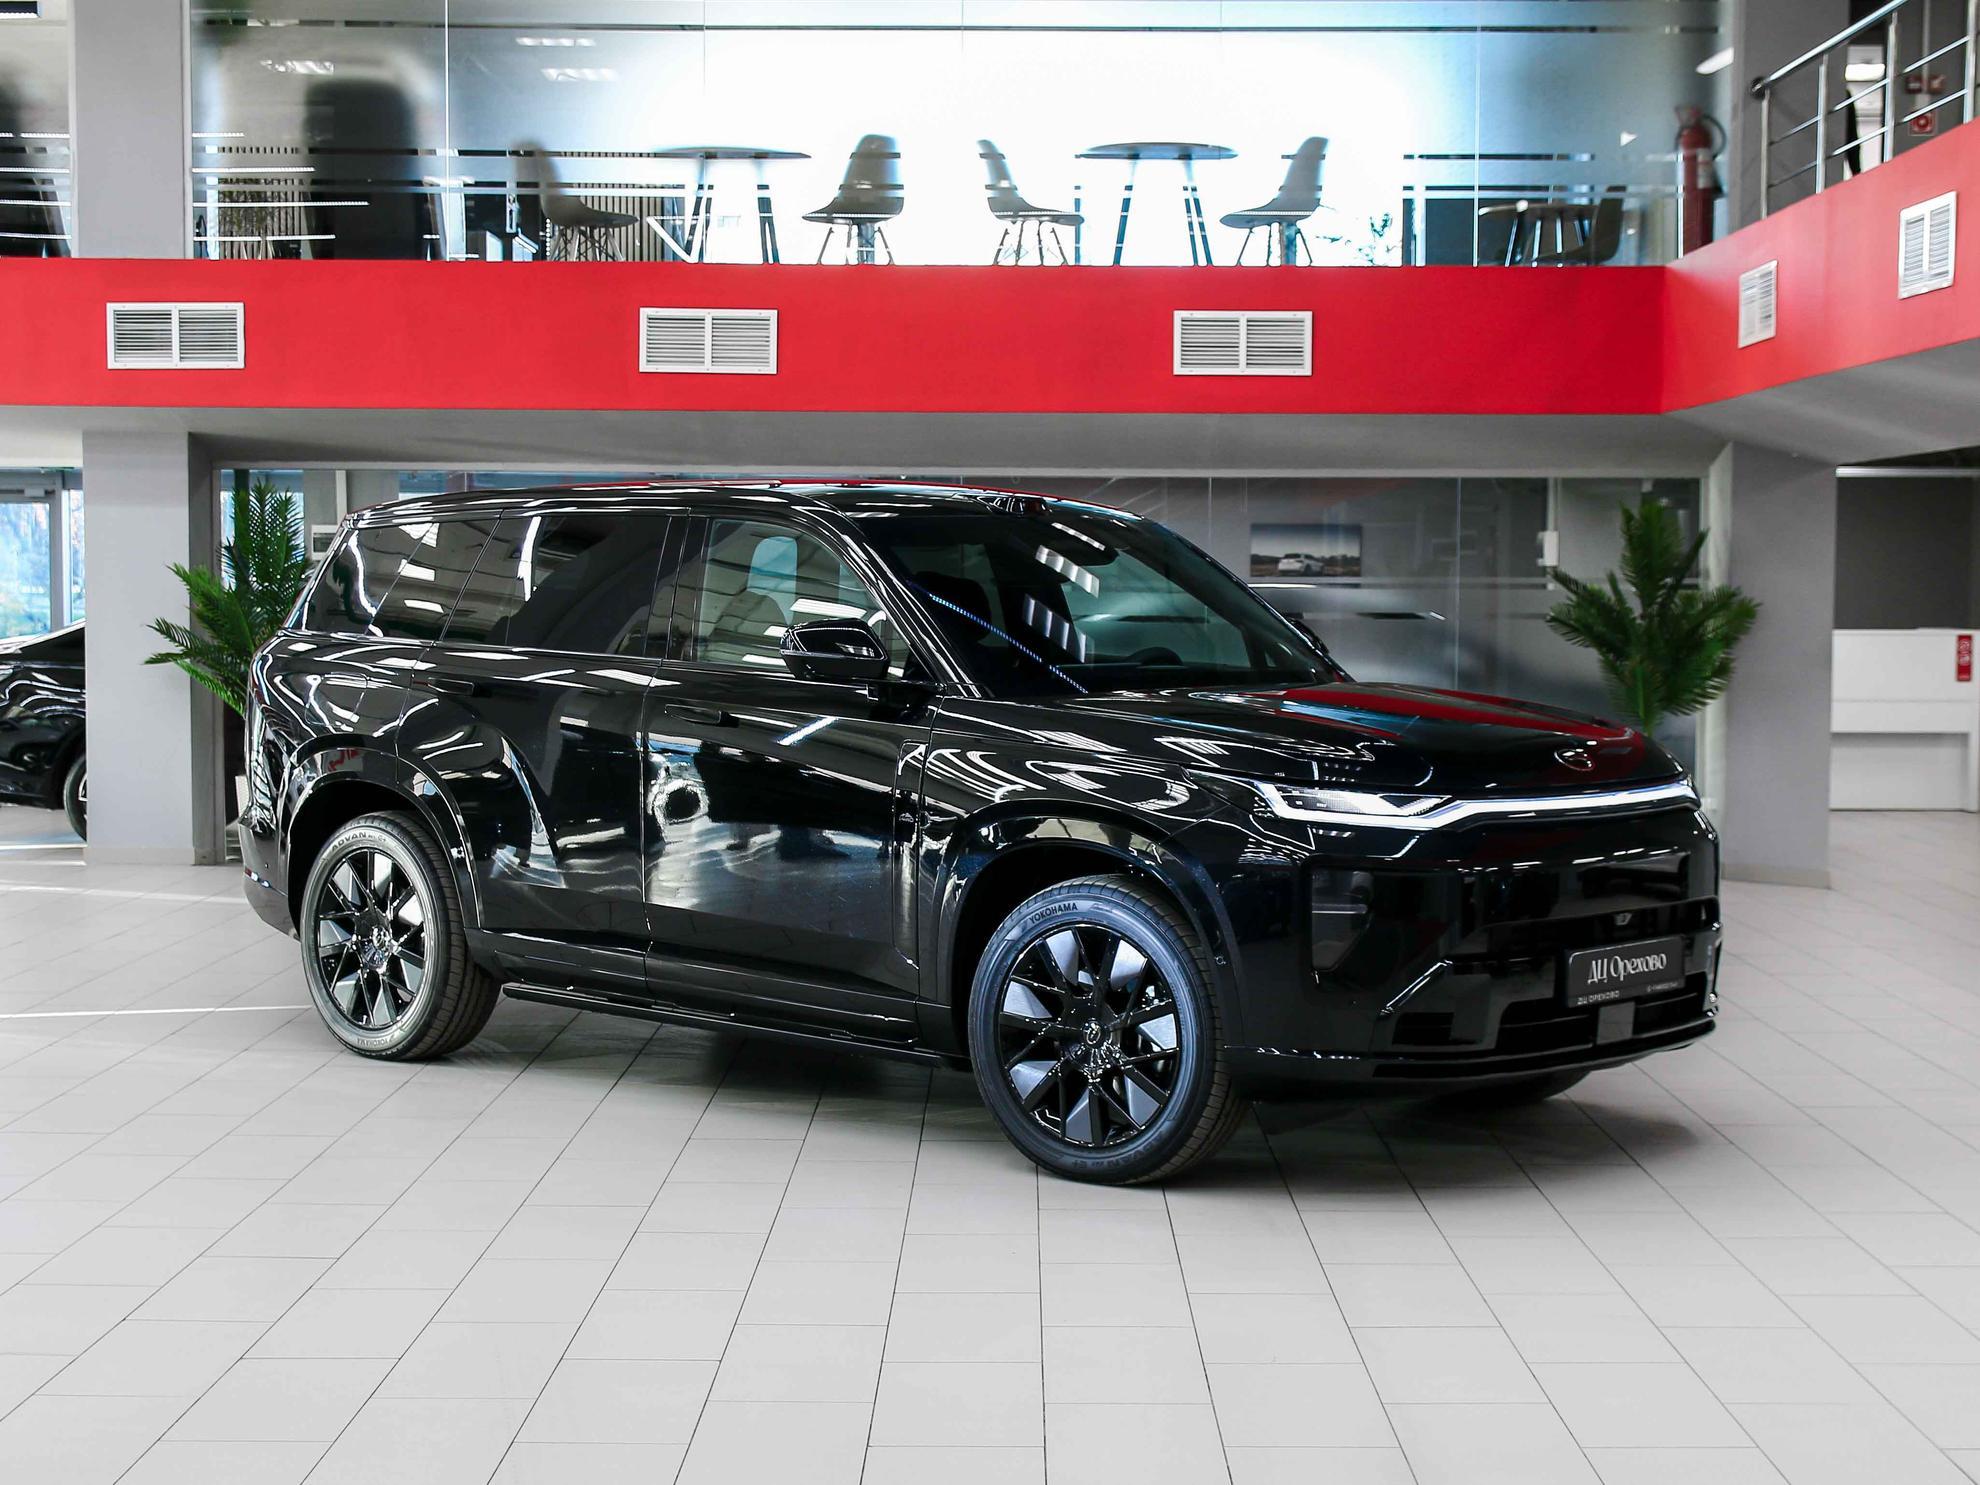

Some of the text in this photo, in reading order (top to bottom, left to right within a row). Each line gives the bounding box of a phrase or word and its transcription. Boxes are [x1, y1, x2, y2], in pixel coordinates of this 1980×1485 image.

[331, 831, 367, 851] ADVAN
[1029, 902, 1078, 924] YOKOHAMA
[1587, 953, 1667, 985] ДЦ Орехово
